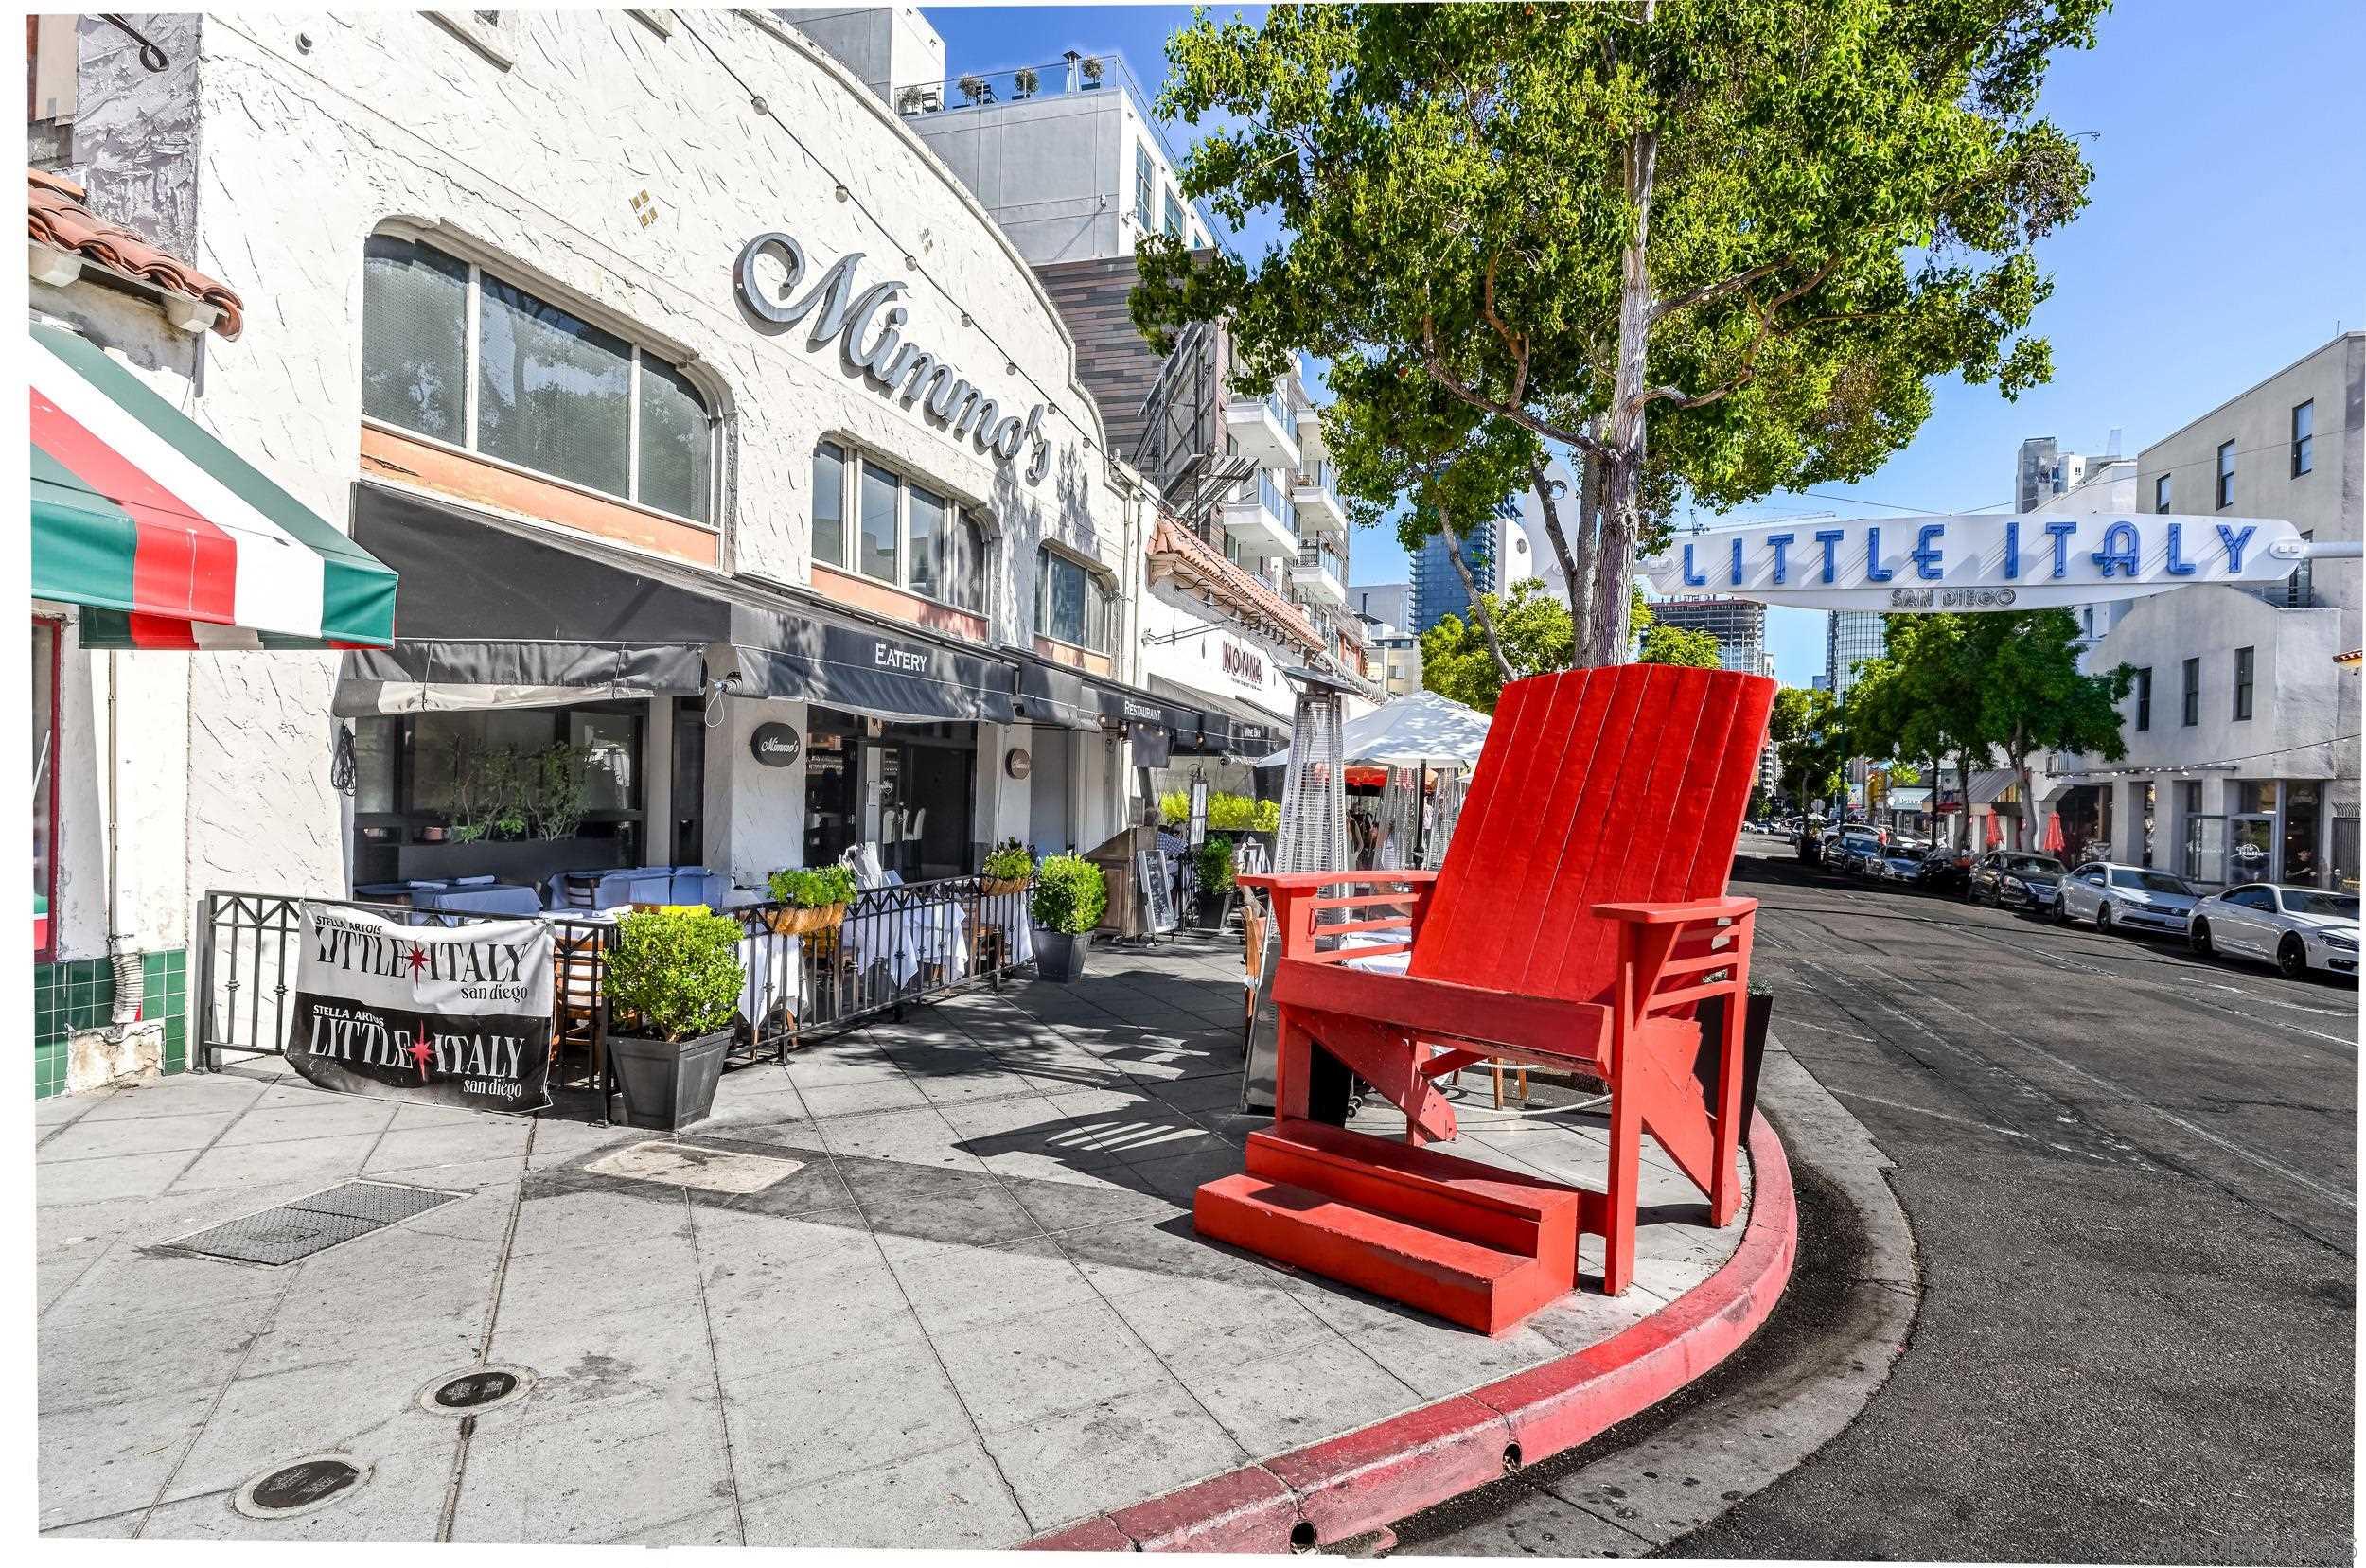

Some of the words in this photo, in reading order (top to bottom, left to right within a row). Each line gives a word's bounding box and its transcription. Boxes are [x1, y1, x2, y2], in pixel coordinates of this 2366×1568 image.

[733, 232, 1051, 484] Mimmo's
[1683, 523, 1945, 586] LITTLE
[2003, 520, 2257, 580] ITALY
[1891, 590, 1933, 608] SAN
[1942, 588, 2017, 608] DIEGO
[874, 643, 927, 672] EATERY
[1222, 640, 1262, 683] NONNA
[1124, 700, 1162, 721] RESTAURANT
[760, 736, 799, 754] Mimmo's
[315, 915, 347, 930] STELLA
[348, 922, 383, 935] ARTOIS
[429, 942, 530, 983] ITALY
[461, 986, 487, 1000] san
[488, 984, 528, 1004] diego
[313, 1004, 350, 1019] STELLA
[308, 1015, 415, 1070] LITTLE
[433, 1031, 525, 1080] ITALY
[463, 1078, 488, 1095] san
[488, 1077, 522, 1101] diego
